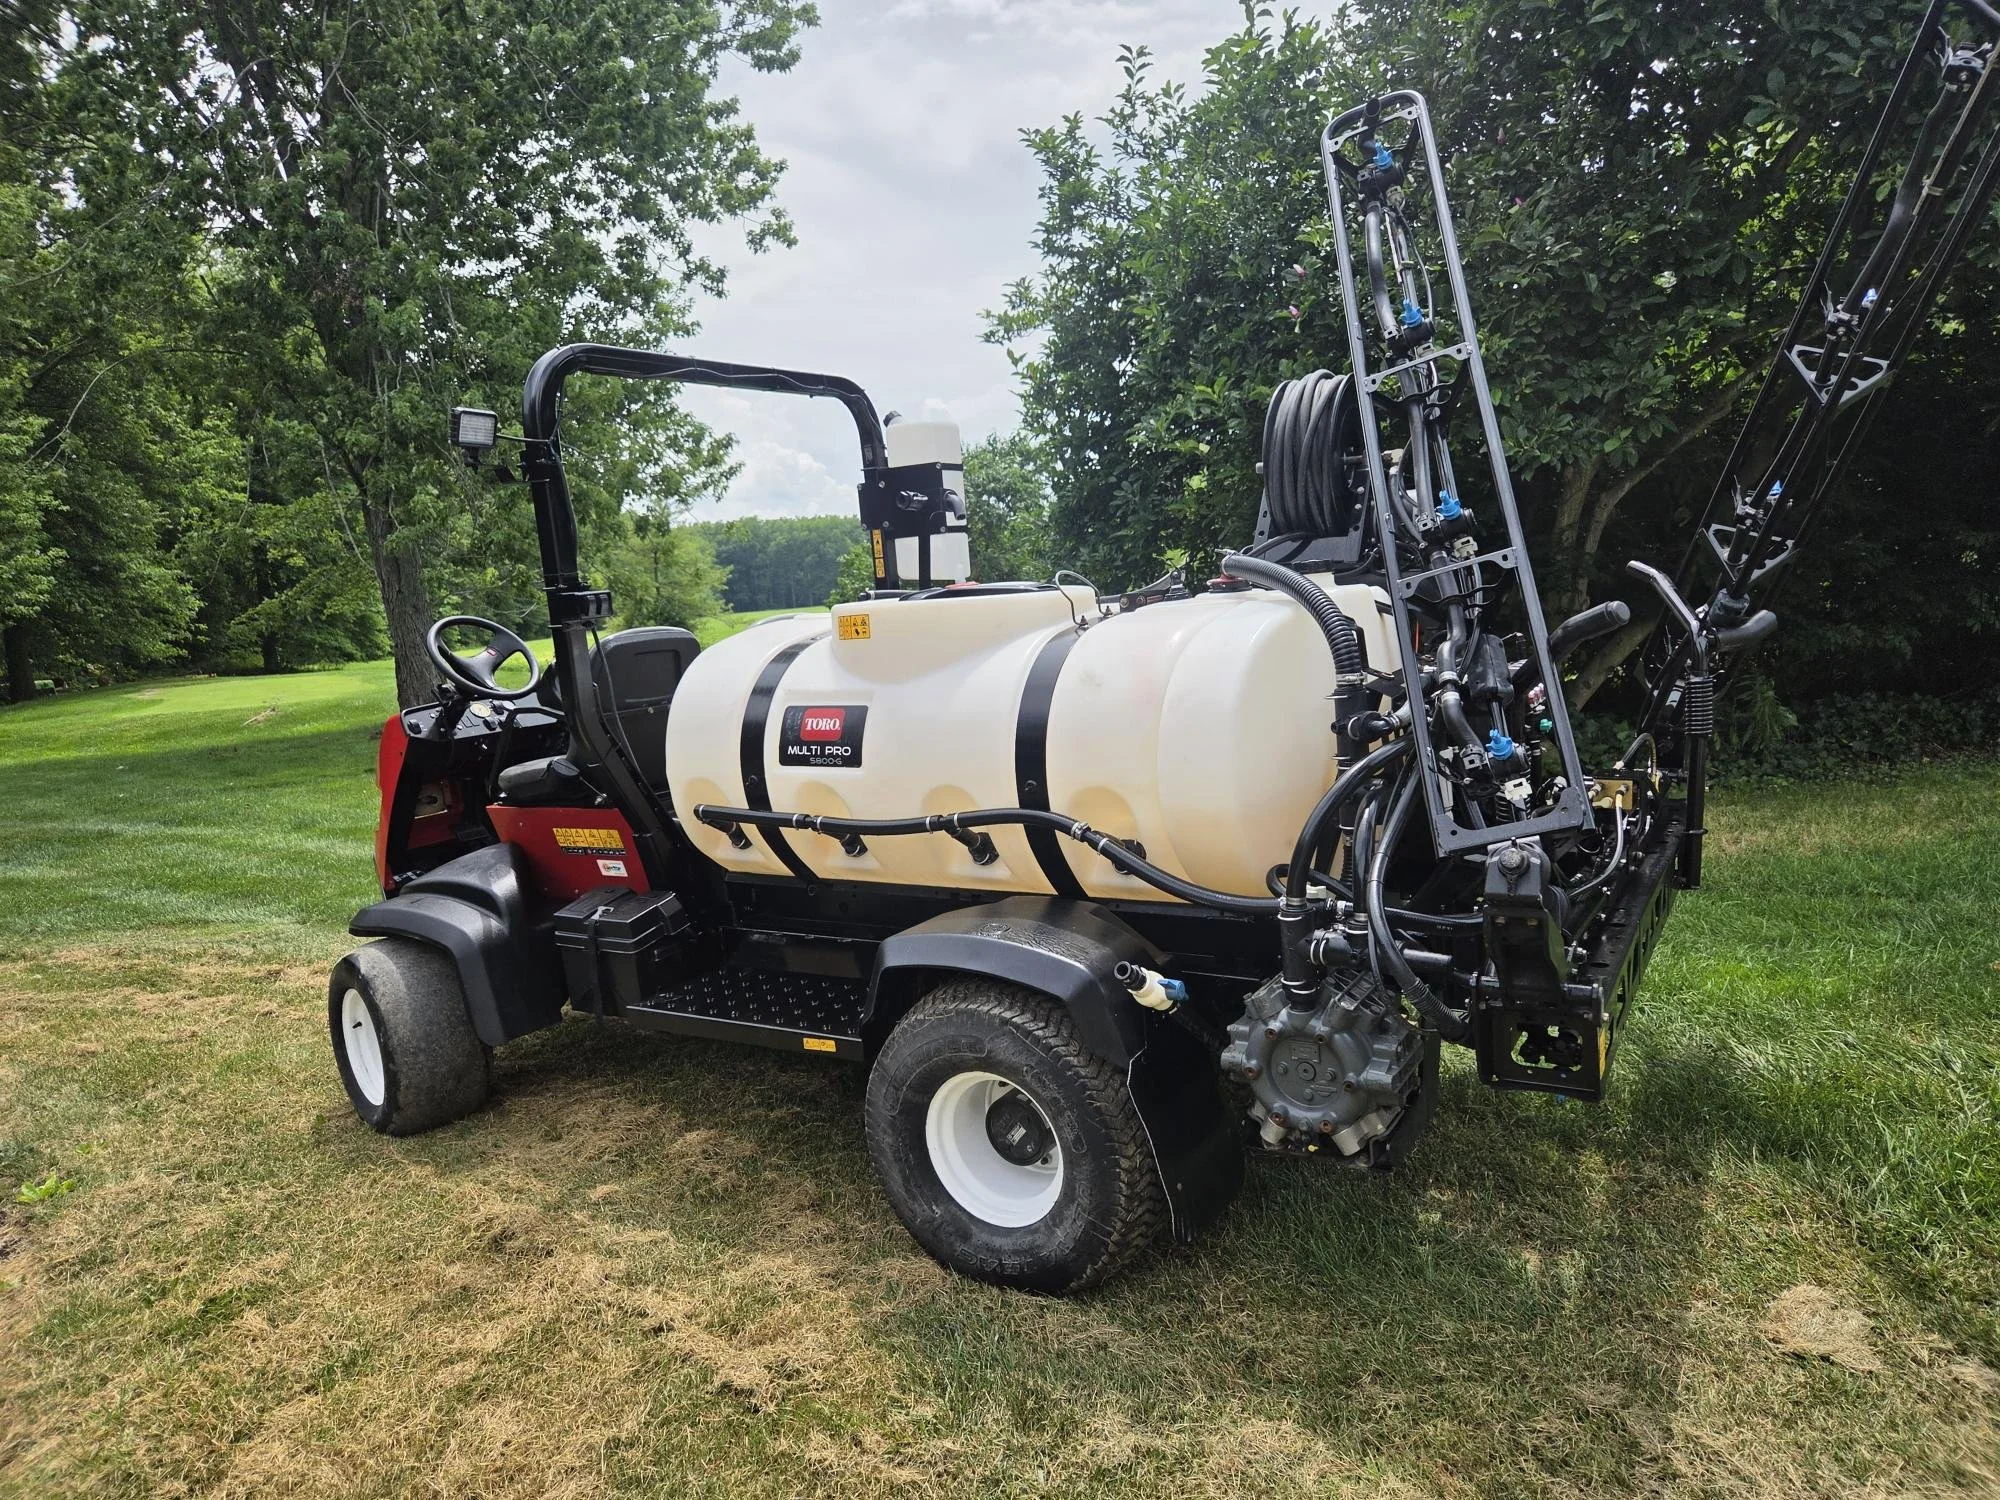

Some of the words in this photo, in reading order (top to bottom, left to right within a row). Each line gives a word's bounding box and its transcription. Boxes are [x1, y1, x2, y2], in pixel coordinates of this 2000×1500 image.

[805, 718, 841, 731] TORO
[788, 745, 820, 756] MULTI
[825, 746, 851, 756] PRO
[809, 757, 842, 765] 5800-G
